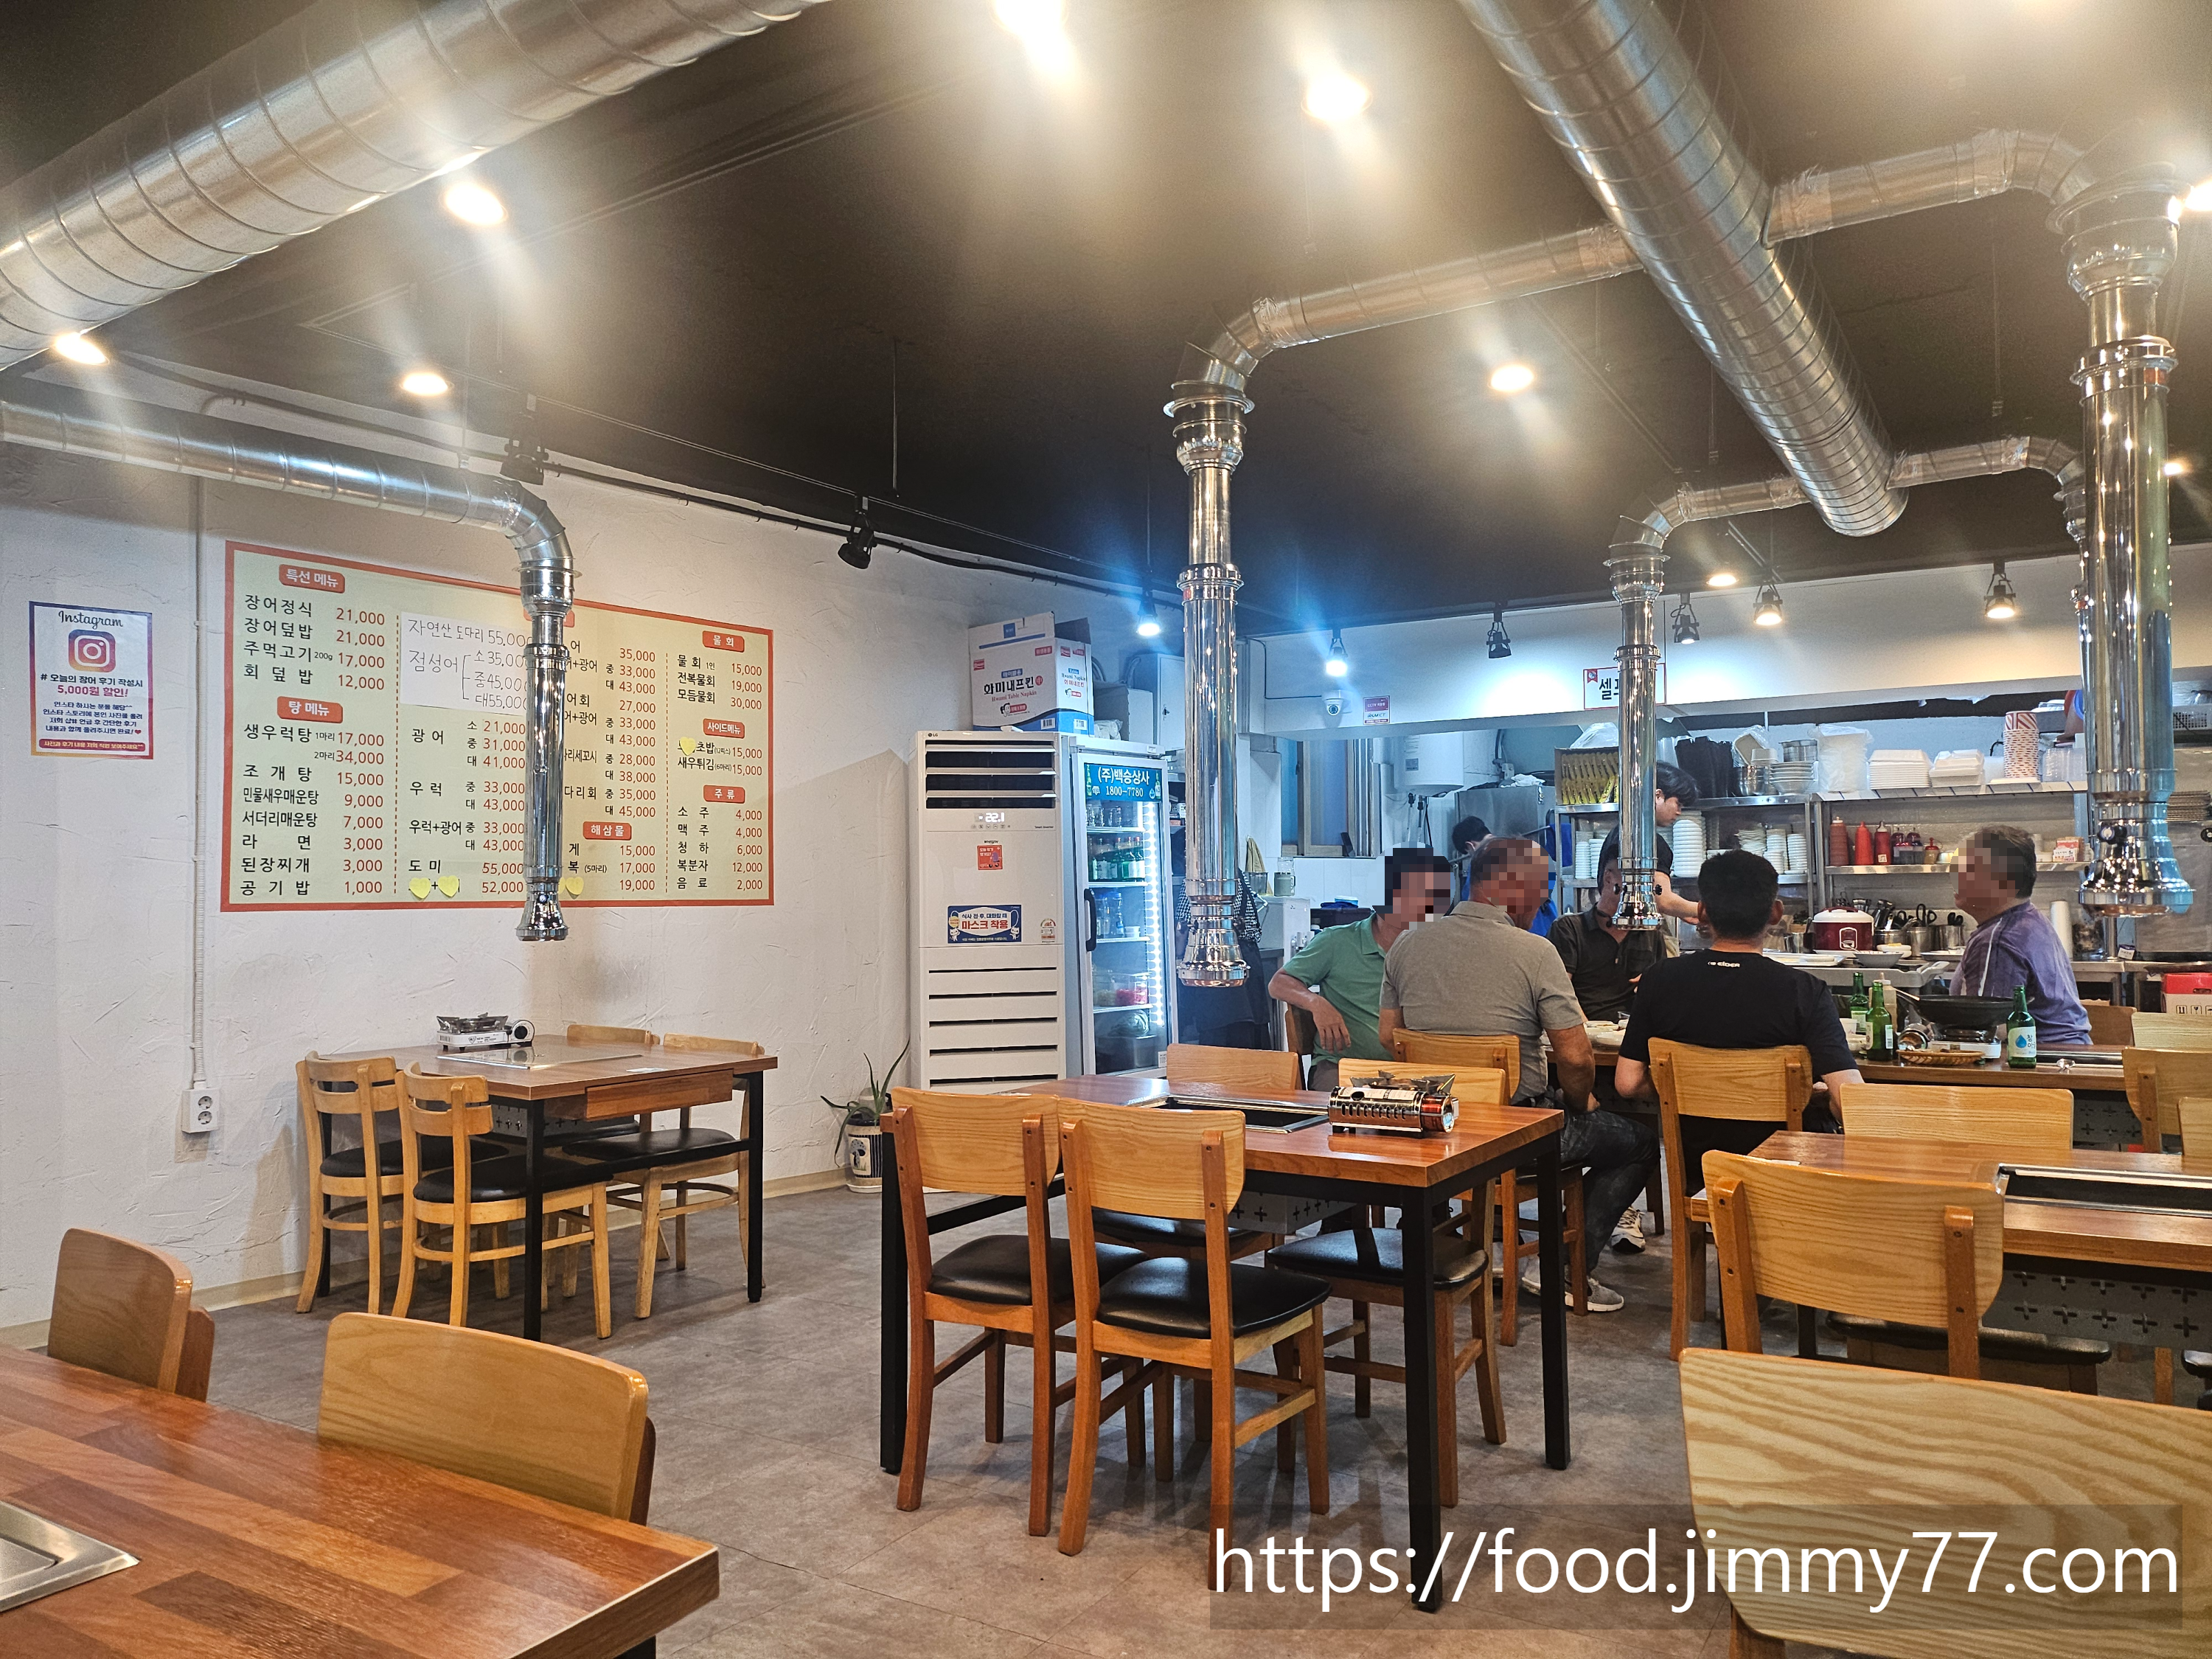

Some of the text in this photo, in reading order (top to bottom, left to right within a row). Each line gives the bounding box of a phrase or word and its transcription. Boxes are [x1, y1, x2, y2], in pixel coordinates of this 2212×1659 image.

[286, 569, 338, 588] 특선 메뉴
[244, 594, 385, 625] 장어정식 21,000
[58, 611, 123, 630] Instagram
[244, 617, 385, 647] 장어덮밥 21,000
[408, 619, 452, 639] 자연산
[456, 626, 484, 643] 도다리
[243, 641, 385, 669] 주먹고기 200g 17,000
[409, 650, 458, 672] 점성어
[474, 650, 527, 668] 소 35.00
[619, 648, 655, 662] 35,000
[606, 664, 655, 678] 중 33,000
[706, 662, 715, 670] 1인
[731, 663, 762, 676] 15,000
[50, 674, 76, 683] 오늘의
[79, 676, 96, 684] 장어
[99, 677, 115, 686] 후기
[118, 678, 143, 687] 작성시
[338, 675, 385, 691] 12,000
[605, 680, 655, 694] 대 43,000
[678, 672, 762, 693] 전복물회 19,000
[984, 677, 1034, 695] 화미내프킨
[58, 685, 128, 698] 5,000원 할인!
[678, 689, 762, 709] 모듬물회 30,000
[288, 700, 330, 717] 탕 메뉴
[619, 700, 656, 713] 27,000
[467, 721, 477, 730] 소
[484, 720, 526, 734] 21,000
[605, 717, 656, 730] 중 33,000
[708, 723, 741, 735] 사이드메뉴
[243, 723, 385, 748] 생우럭탕 1마리 17,000
[605, 734, 656, 747] 대 43,000
[467, 738, 526, 751] 중 31,000
[313, 750, 385, 765] 2마리 34,000
[605, 754, 656, 766] 중 28,000
[732, 747, 762, 759] 15,000
[467, 756, 526, 769] 대 41,000
[605, 770, 656, 783] 대 38,000
[732, 765, 762, 776] 15,000
[1098, 767, 1150, 785] (주)백승상사
[337, 772, 384, 787] 15,000
[465, 782, 476, 793] 중
[484, 781, 525, 795] 33,000
[605, 789, 614, 799] 중
[619, 788, 656, 801] 35,000
[1105, 786, 1144, 797] 1800-7780
[243, 787, 383, 809] 민물새우매운탕 9,000
[465, 799, 525, 812] 대 43,000
[605, 805, 656, 818] 대 45,000
[242, 810, 383, 830] 서더리매운탕 7,000
[736, 810, 762, 821] 4,000
[409, 820, 524, 835] 우럭+광어 중 33,000
[736, 827, 762, 838] 4,000
[343, 837, 383, 852] 3,000
[465, 840, 524, 852] 대 43,000
[620, 845, 655, 858] 15,000
[737, 845, 762, 856] 6,000
[343, 859, 383, 873] 3,000
[482, 862, 524, 876] 55,000
[584, 863, 655, 874] (5마리) 17,000
[678, 859, 762, 873] 복분자 12,000
[344, 880, 383, 894] 1,000
[481, 881, 524, 894] 52,000
[619, 880, 655, 891] 19,000
[737, 880, 762, 891] 2,000
[961, 920, 988, 929] 마스크
[990, 920, 1008, 929] 착용
